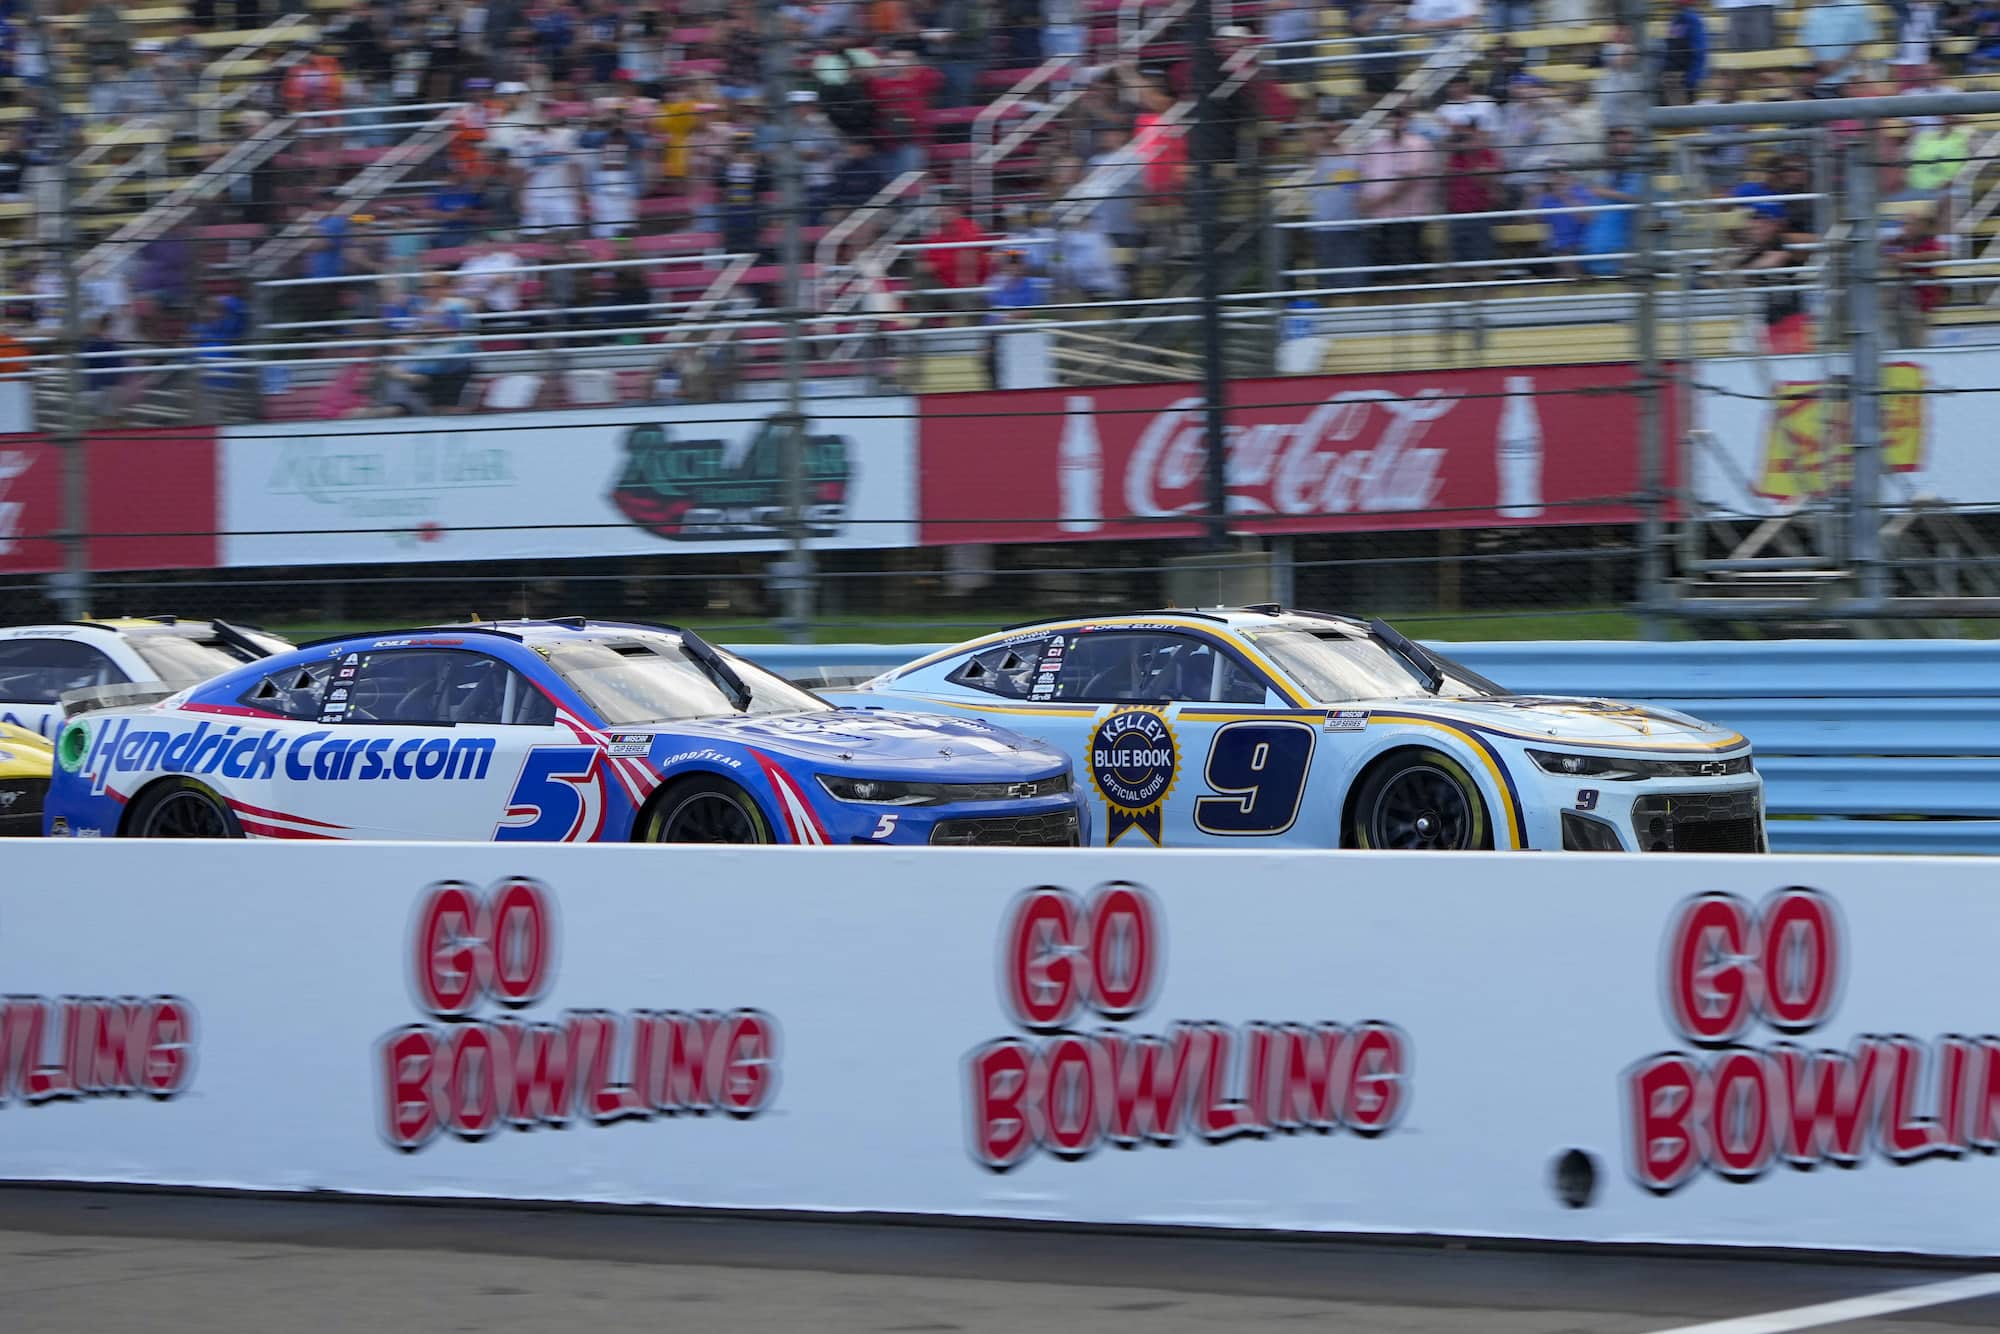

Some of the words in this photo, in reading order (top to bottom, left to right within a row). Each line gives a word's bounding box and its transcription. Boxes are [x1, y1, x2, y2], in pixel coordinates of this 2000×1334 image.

[83, 718, 497, 793] HendrickCars.com
[663, 748, 742, 769] GOODYEAR
[1095, 749, 1131, 767] BLUE
[1133, 749, 1171, 767] BOOK
[1102, 714, 1167, 742] KELLEY
[493, 743, 604, 842] 5
[1103, 773, 1140, 800] OFFICIAL
[1140, 773, 1165, 799] GUIDE
[1193, 720, 1317, 837] 9
[1575, 789, 1599, 811] 9
[871, 814, 900, 839] 5
[407, 876, 560, 1022] GO
[1000, 880, 1166, 1034] GO
[1659, 886, 1848, 1049] GO
[374, 1008, 782, 1153] BOWLING
[961, 1020, 1411, 1173] BOWLING
